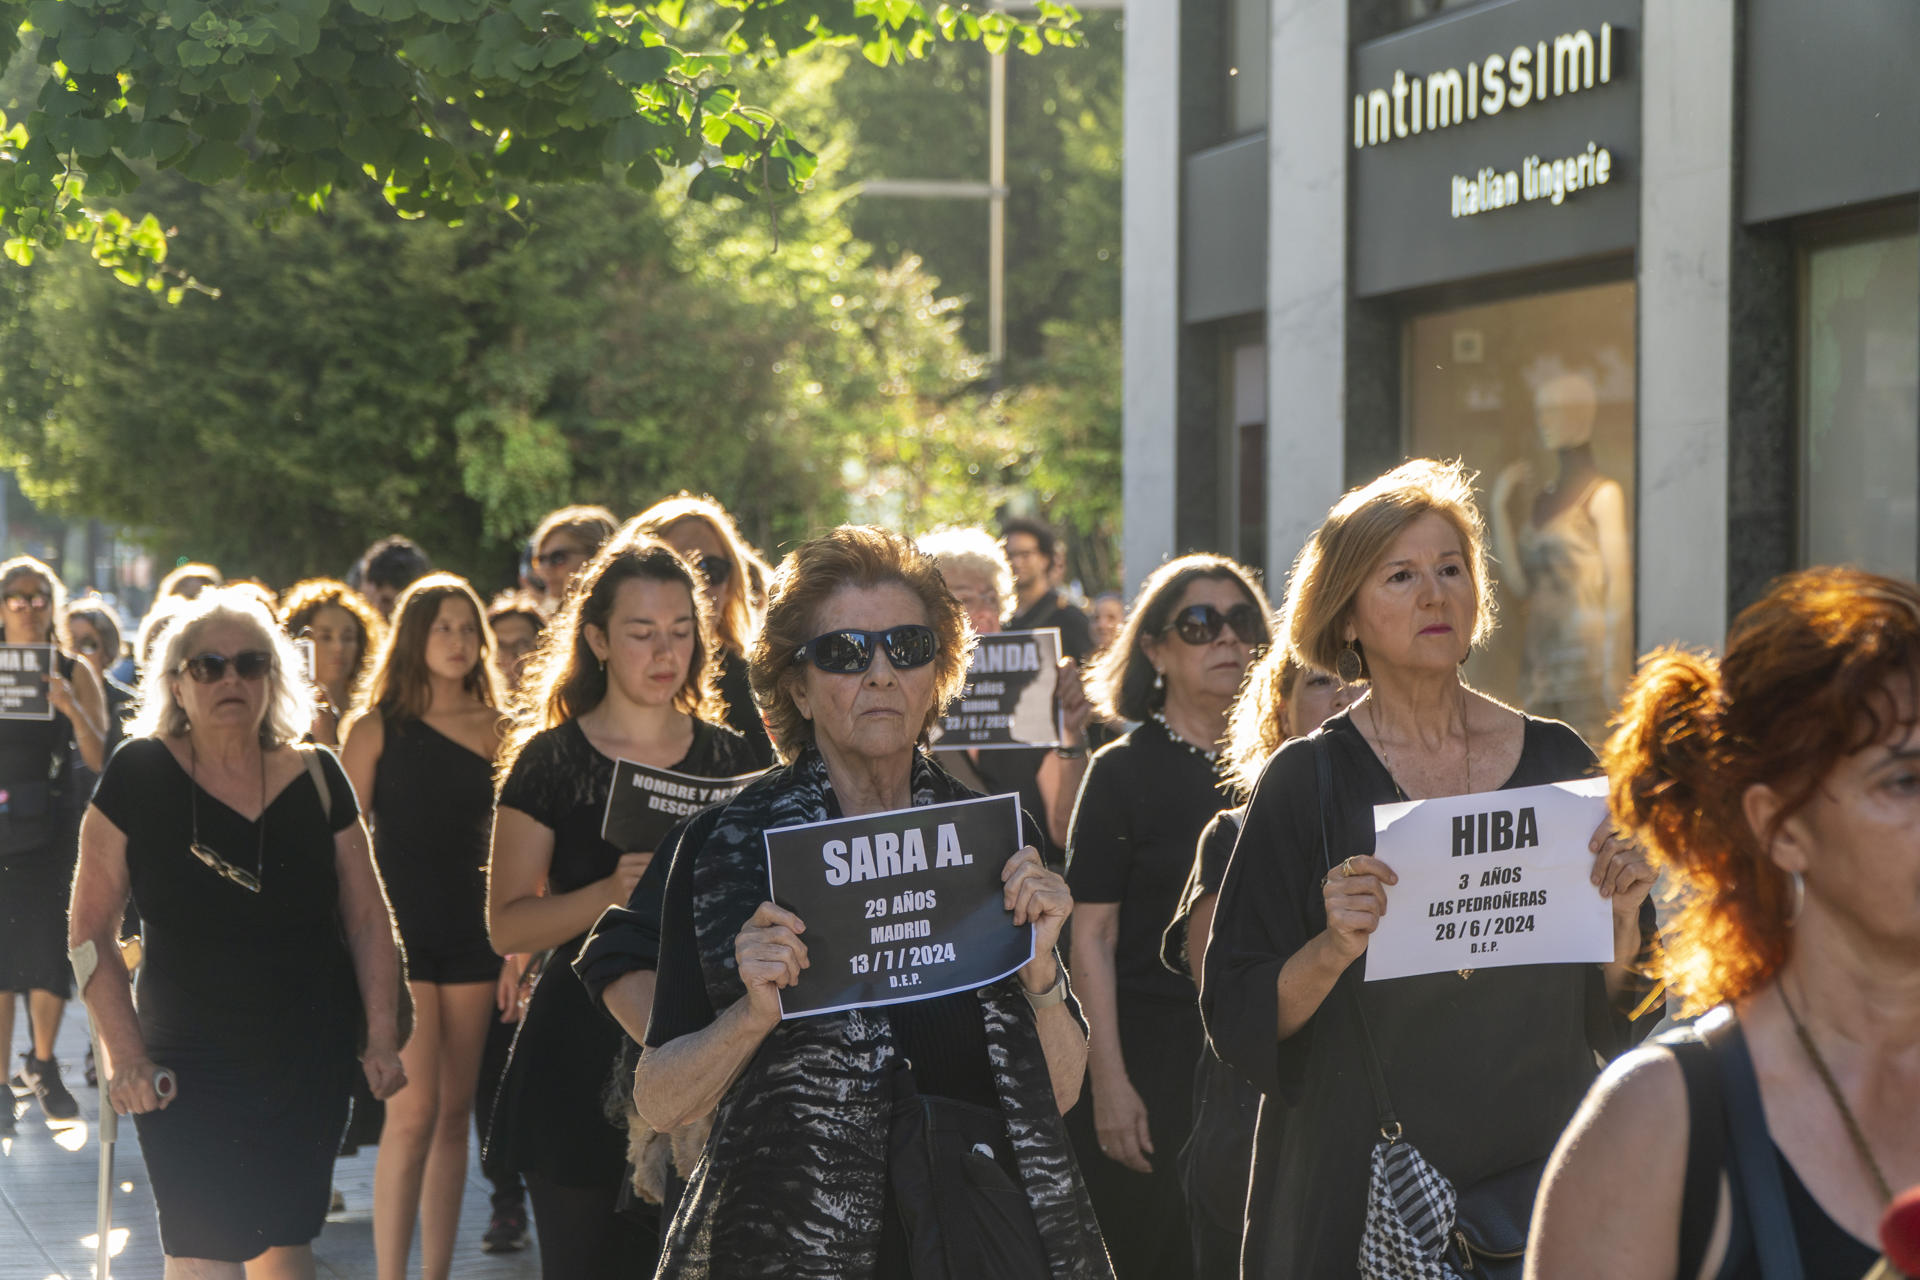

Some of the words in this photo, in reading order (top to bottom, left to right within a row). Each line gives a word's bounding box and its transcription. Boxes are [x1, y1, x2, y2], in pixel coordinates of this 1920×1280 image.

[1354, 21, 1612, 149] intimissimi
[1452, 166, 1519, 218] Italian
[1523, 141, 1611, 205] lingerie
[966, 642, 1040, 674] ANDA
[632, 773, 696, 801] NOMBRE
[699, 788, 709, 802] Y
[648, 795, 705, 816] DESCO
[1452, 806, 1539, 858] HIBA
[822, 828, 928, 886] SARA
[935, 823, 974, 868] A.
[1459, 874, 1469, 890] 3
[1480, 866, 1522, 887] AÑOS
[865, 898, 887, 919] 29
[892, 889, 936, 915] AÑOS
[1428, 900, 1454, 918] LAS
[1456, 889, 1547, 914] PEDROÑERAS
[871, 919, 931, 944] MADRID
[1470, 941, 1499, 954] D.E.P.
[889, 972, 922, 988] D.E.P.
